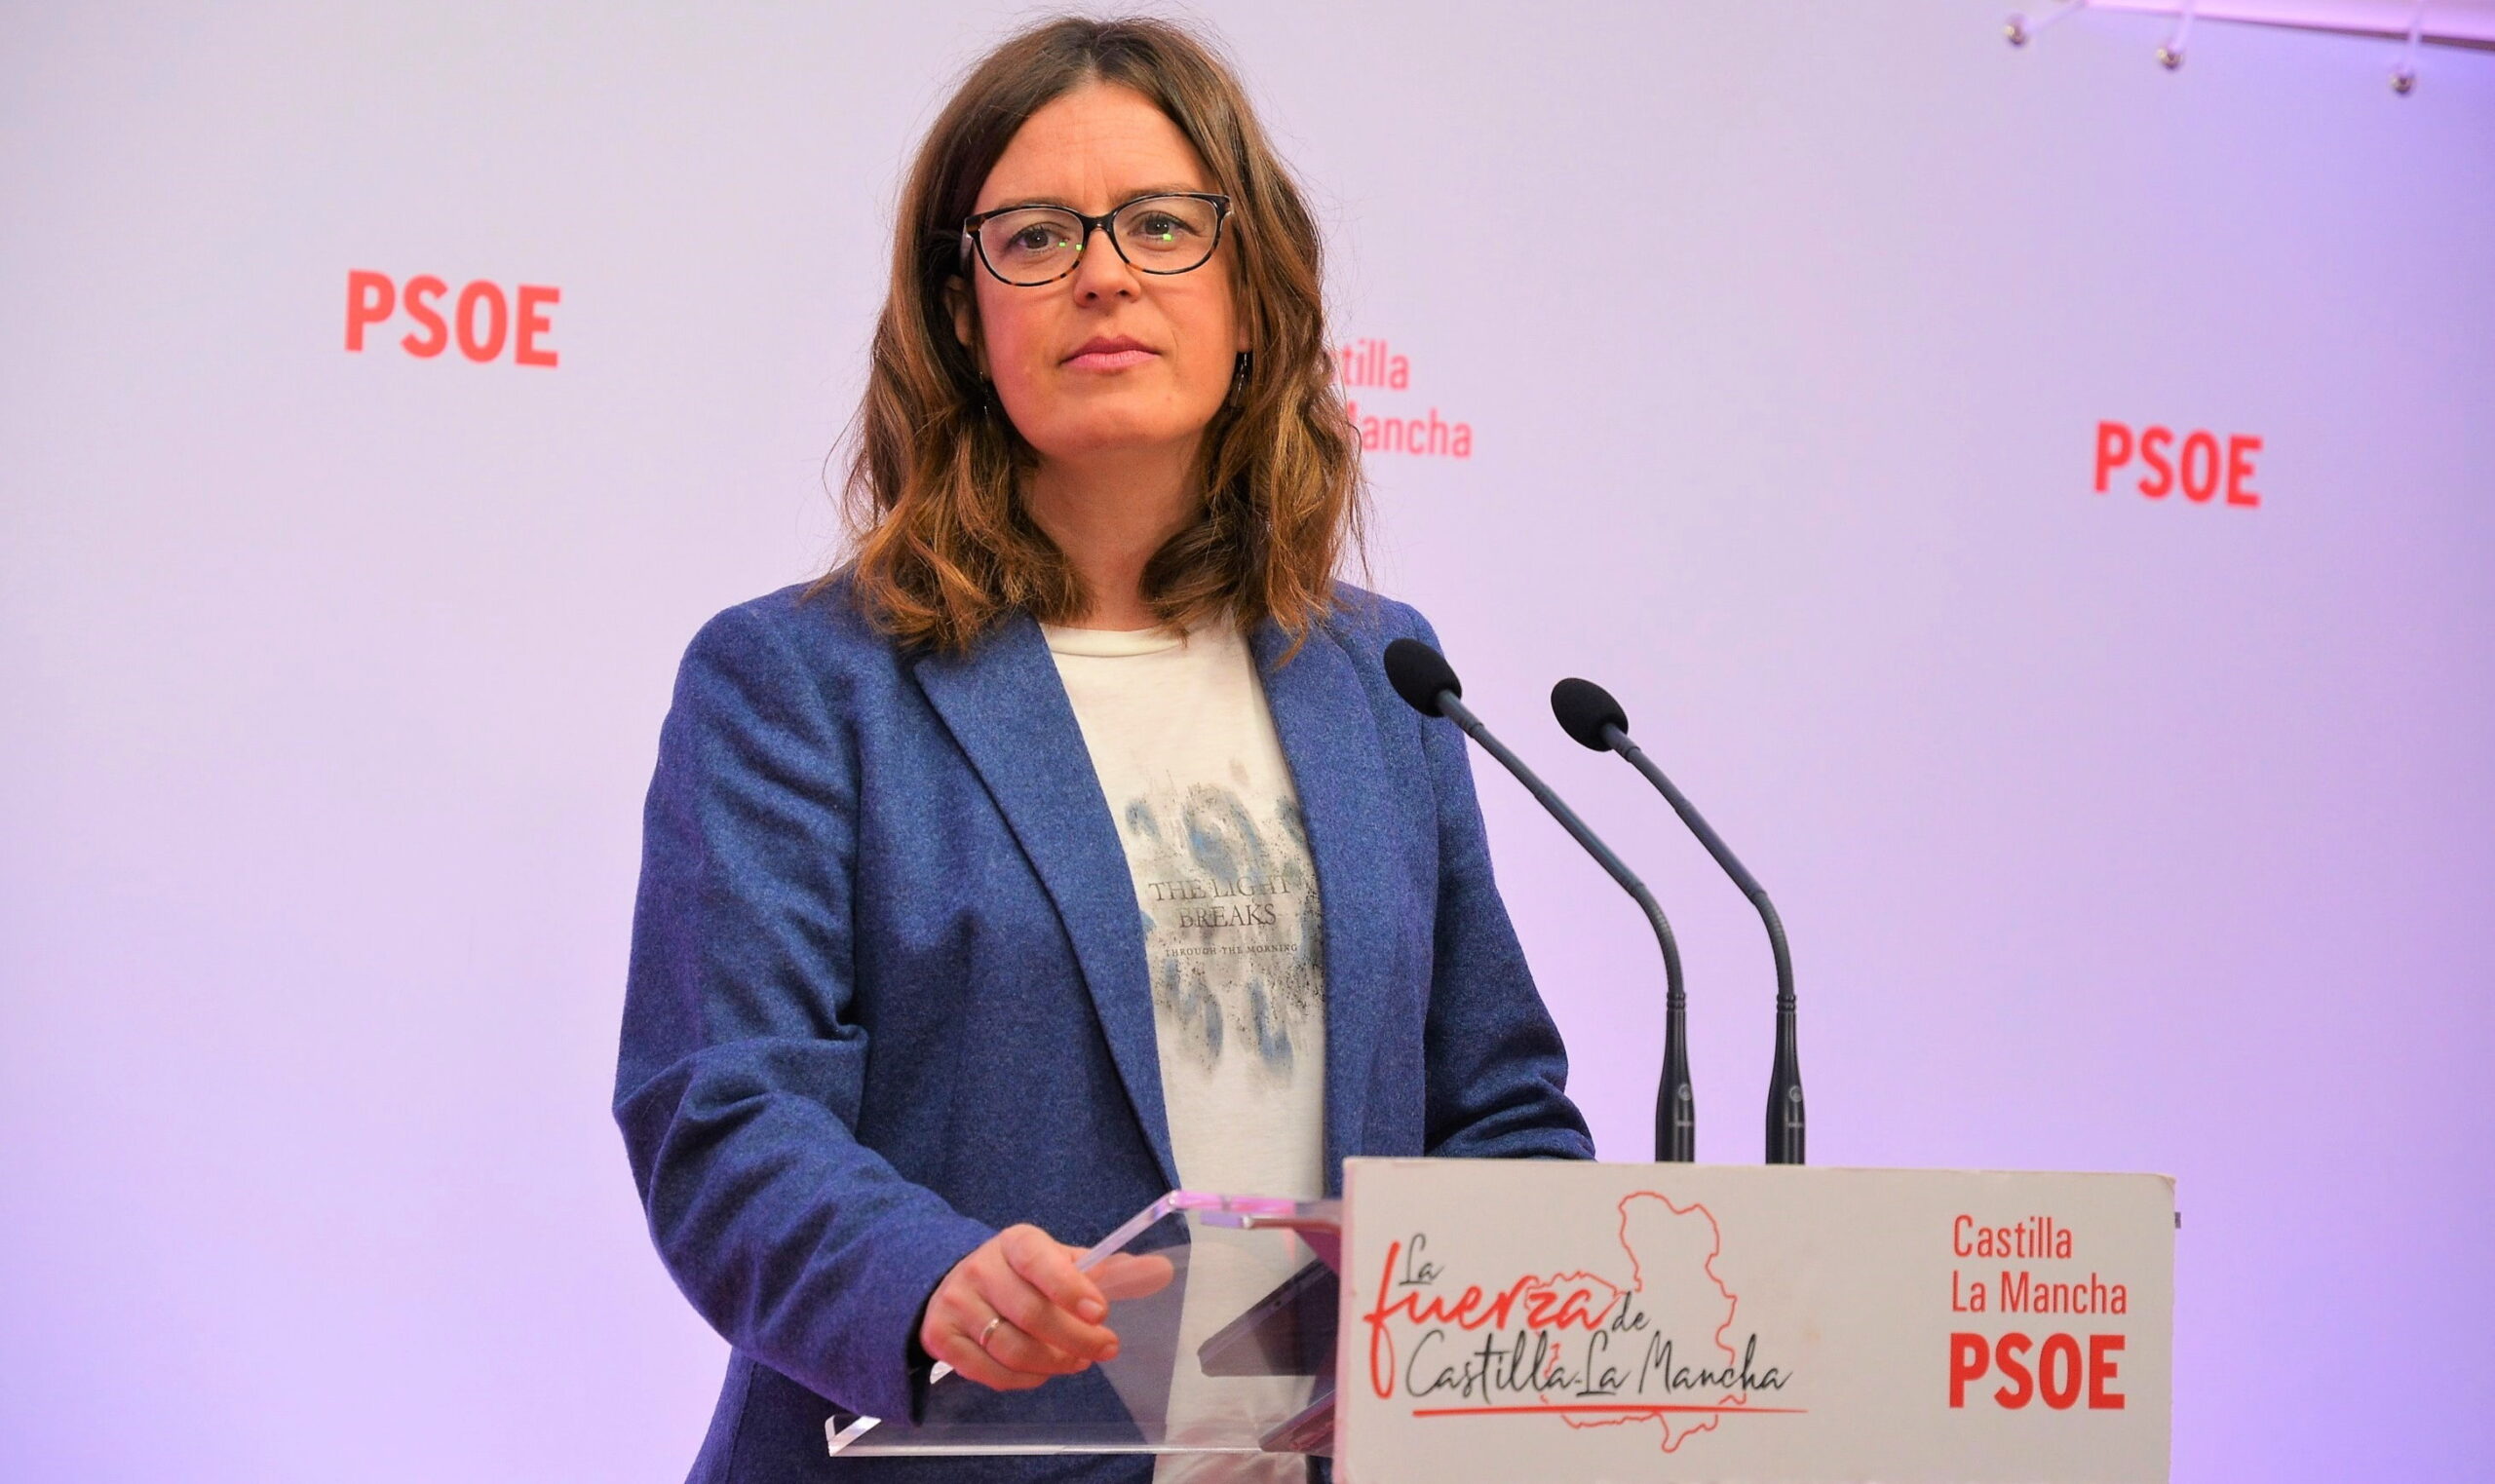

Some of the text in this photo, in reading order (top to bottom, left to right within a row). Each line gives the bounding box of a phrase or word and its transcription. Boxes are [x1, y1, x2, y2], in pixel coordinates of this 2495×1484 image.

[345, 270, 561, 368] PSOE
[2093, 420, 2263, 508] PSOE
[1149, 876, 1290, 901] THE LIGHT
[1178, 903, 1277, 929] BREAKS
[1166, 943, 1298, 957] THROUGH THE MORNING
[1399, 1234, 1443, 1285] La
[1953, 1214, 2072, 1259] Castilla
[1953, 1271, 2127, 1314] La Mancha
[1363, 1241, 1650, 1399] fuerza de
[1638, 1331, 1792, 1394] Mancha
[1949, 1332, 2126, 1410] PSOE
